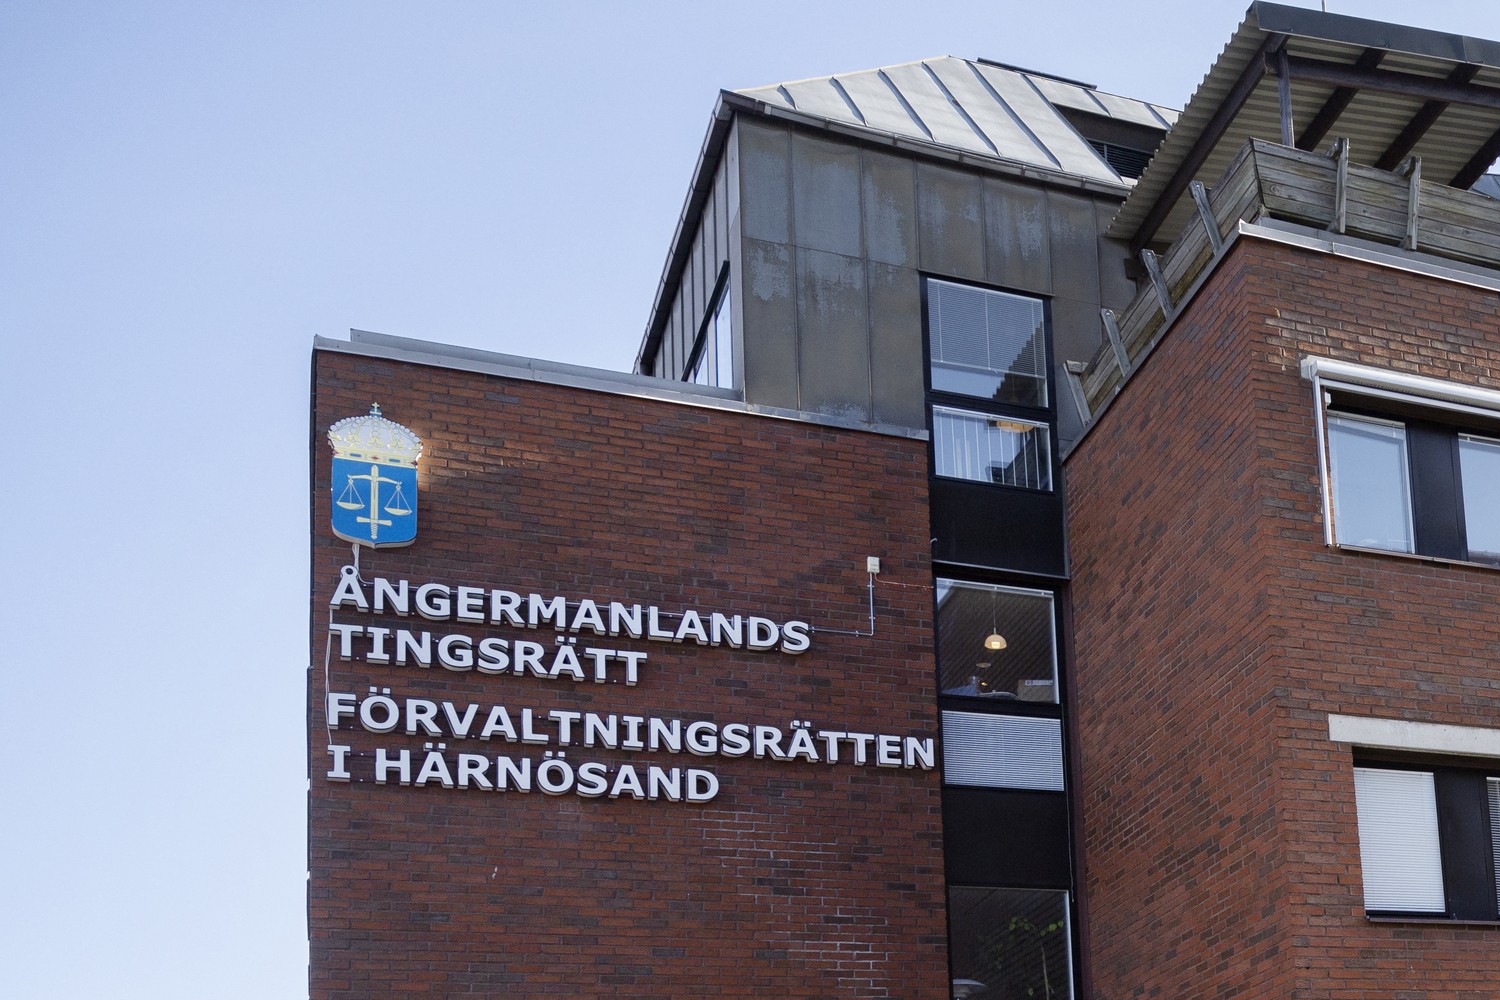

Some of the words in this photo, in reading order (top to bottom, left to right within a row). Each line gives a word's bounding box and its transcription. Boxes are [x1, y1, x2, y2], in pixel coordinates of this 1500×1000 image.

[329, 565, 810, 654] ÅNGERMANLANDS
[329, 622, 647, 686] TINGSRÄTT
[328, 686, 935, 770] FÖRVALTNINGSRÄTTEN
[327, 744, 350, 782] I
[375, 742, 719, 803] HÄRNÖSAND
